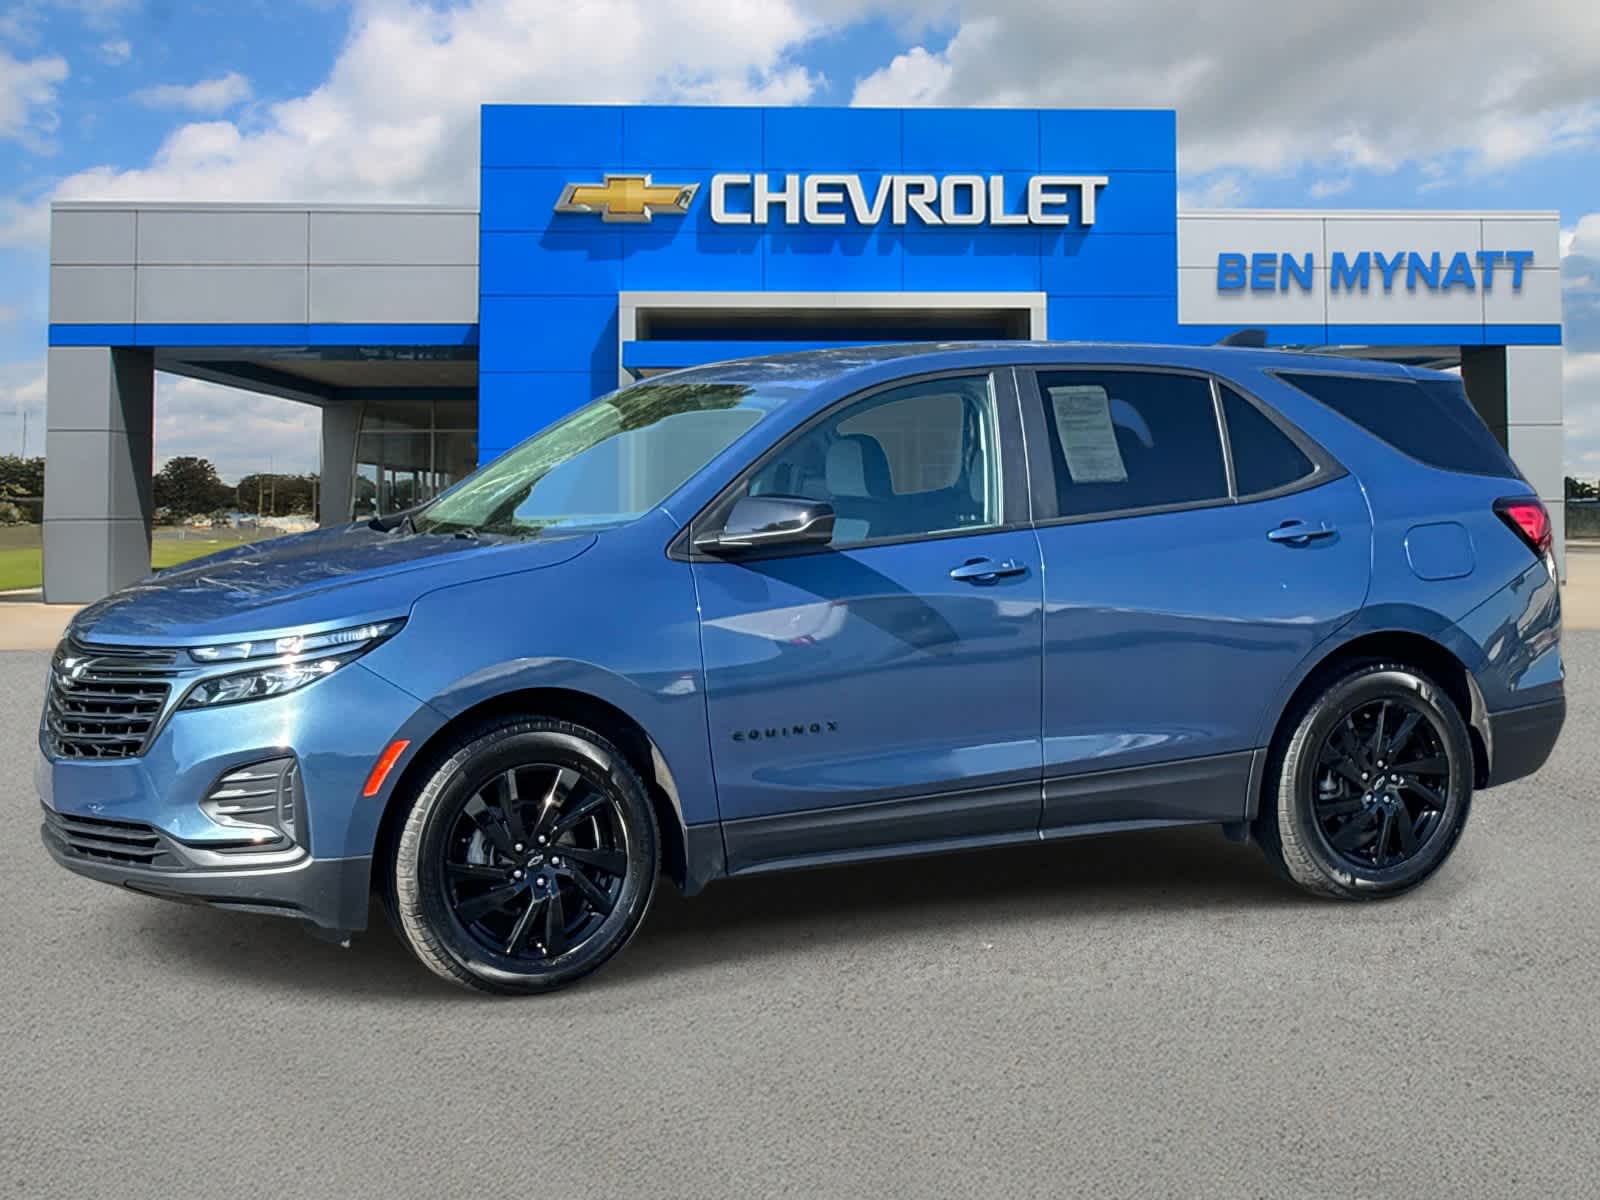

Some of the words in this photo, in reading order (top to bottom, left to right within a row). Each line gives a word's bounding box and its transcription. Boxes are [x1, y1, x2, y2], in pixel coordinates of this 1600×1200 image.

[710, 174, 1109, 225] CHEVROLET
[1217, 252, 1313, 291] BEN
[1330, 251, 1534, 291] MYNATT
[732, 721, 839, 742] EQUINOX
